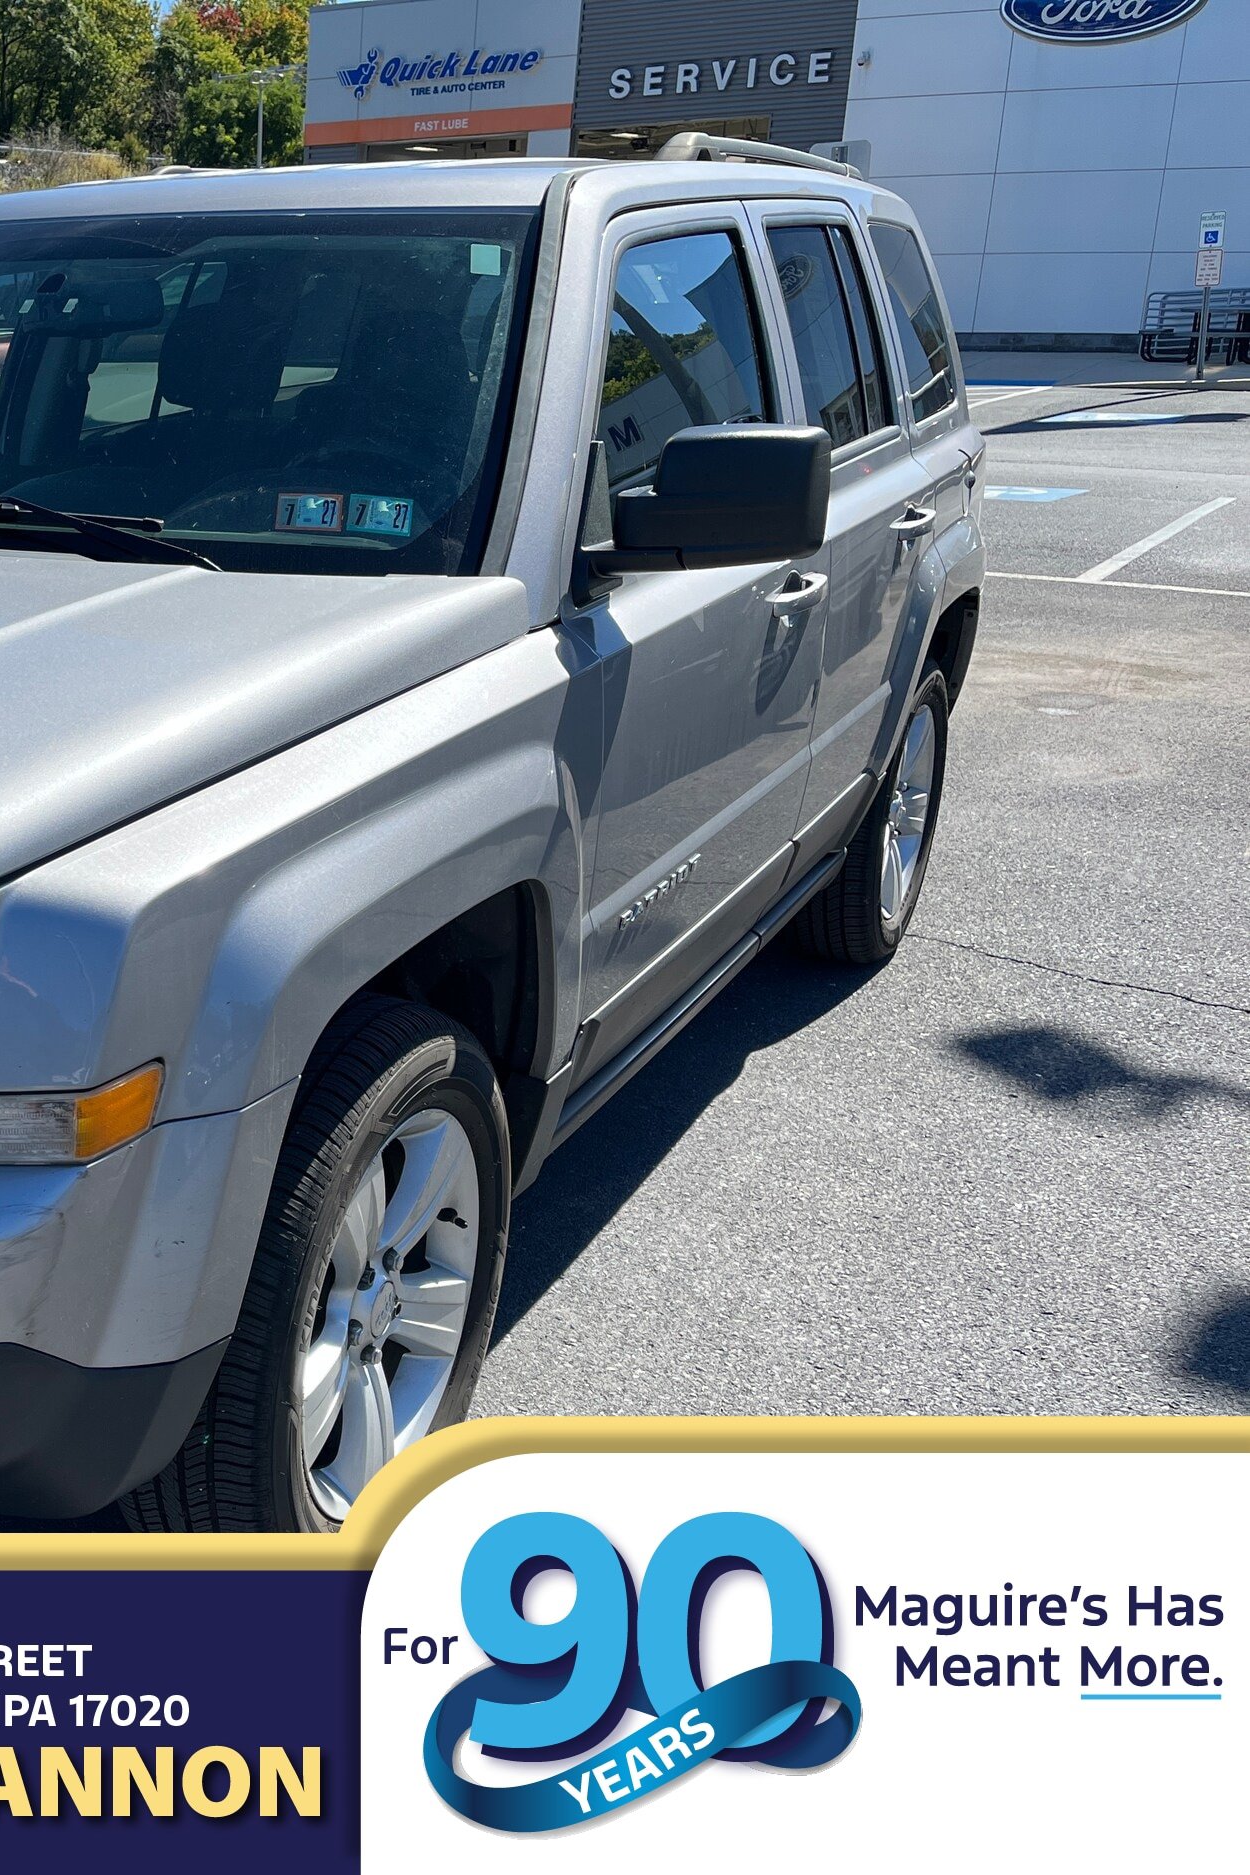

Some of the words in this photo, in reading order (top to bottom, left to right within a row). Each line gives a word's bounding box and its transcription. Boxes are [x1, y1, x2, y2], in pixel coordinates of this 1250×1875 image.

[378, 51, 461, 87] Quick
[462, 49, 541, 77] Lane
[608, 51, 832, 100] SERVICE
[410, 86, 432, 97] TIRE
[432, 85, 440, 95] &
[440, 83, 466, 94] AUTO
[467, 80, 506, 92] CENTER
[413, 119, 439, 132] FAST
[441, 118, 469, 131] LUBE
[284, 503, 296, 526] 7
[321, 500, 337, 527] 27
[354, 503, 367, 526] 7
[392, 503, 409, 532] 27
[618, 853, 701, 931] PATRIOT
